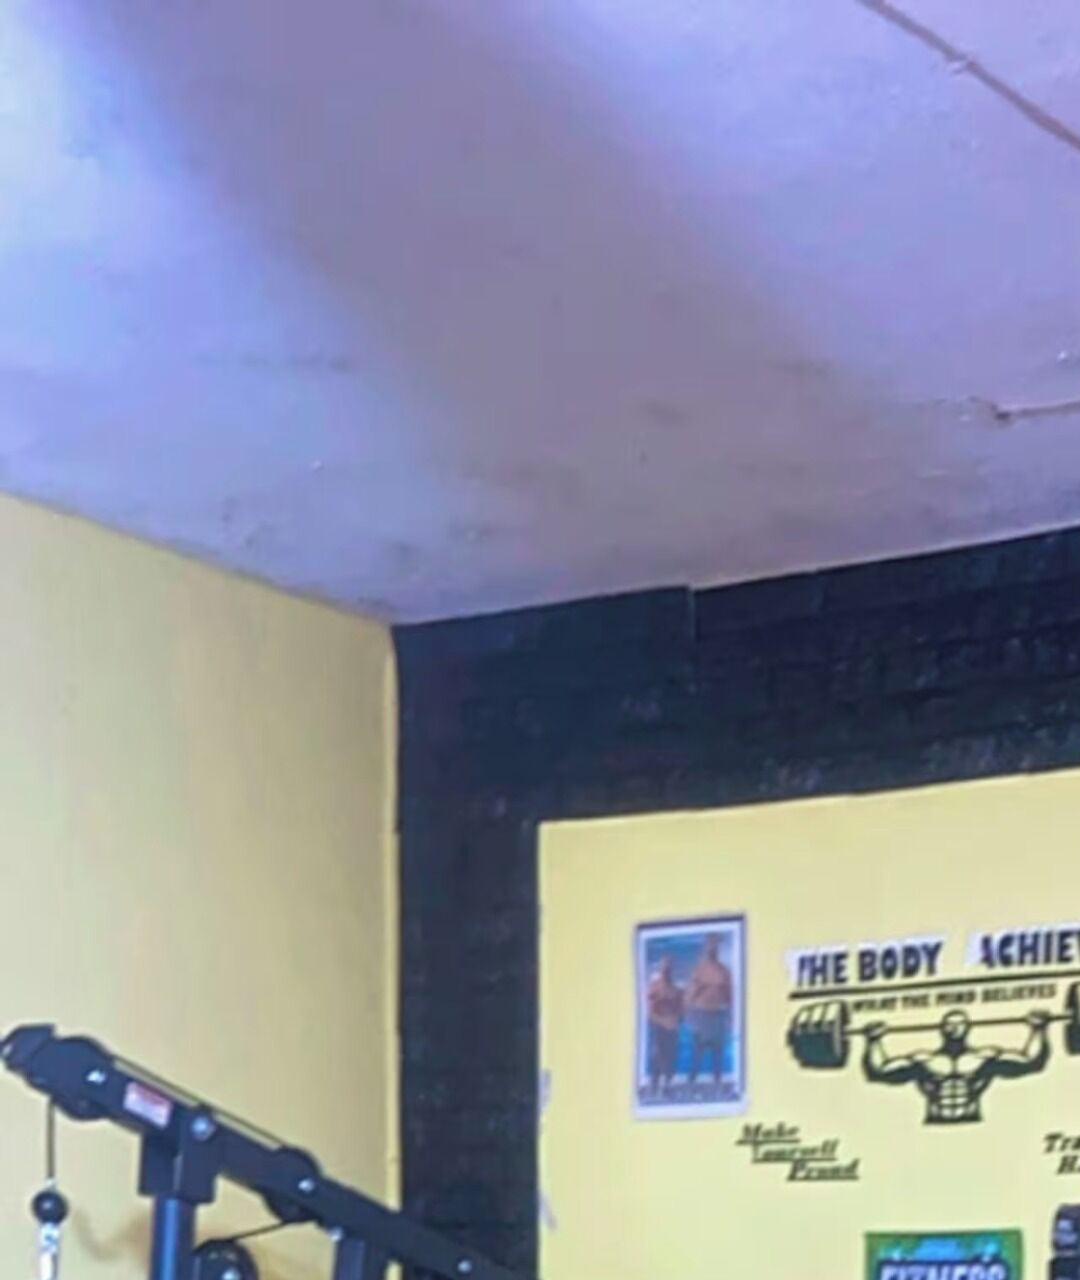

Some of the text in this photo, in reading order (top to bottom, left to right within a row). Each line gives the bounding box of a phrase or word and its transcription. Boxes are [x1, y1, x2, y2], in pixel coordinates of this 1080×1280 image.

[858, 941, 943, 983] BODY
[852, 983, 1057, 1013] WHAT THE MIND BELIEVES
